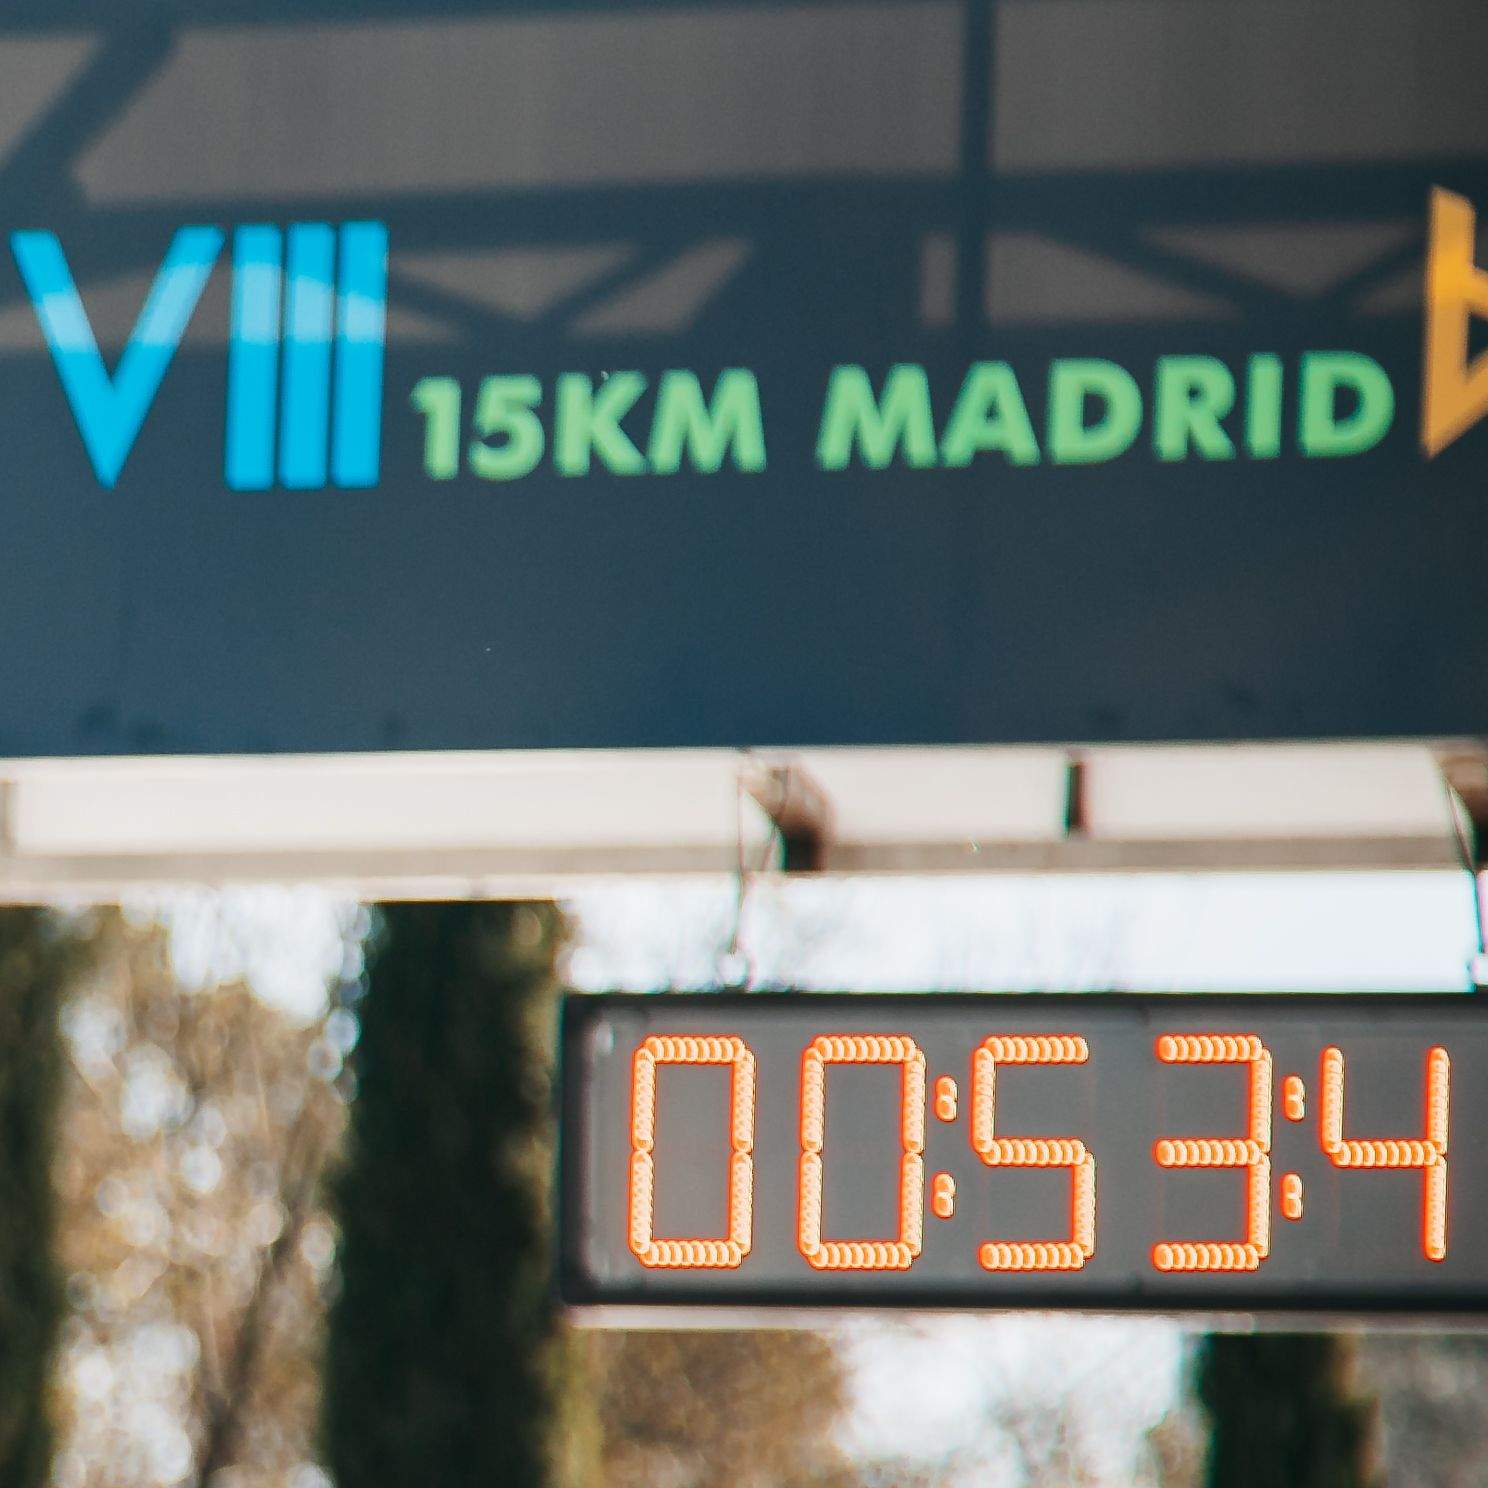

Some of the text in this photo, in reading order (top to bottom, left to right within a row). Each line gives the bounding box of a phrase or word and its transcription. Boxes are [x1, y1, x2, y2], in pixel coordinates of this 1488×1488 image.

[8, 219, 1395, 492] VIII 15KM MADRID
